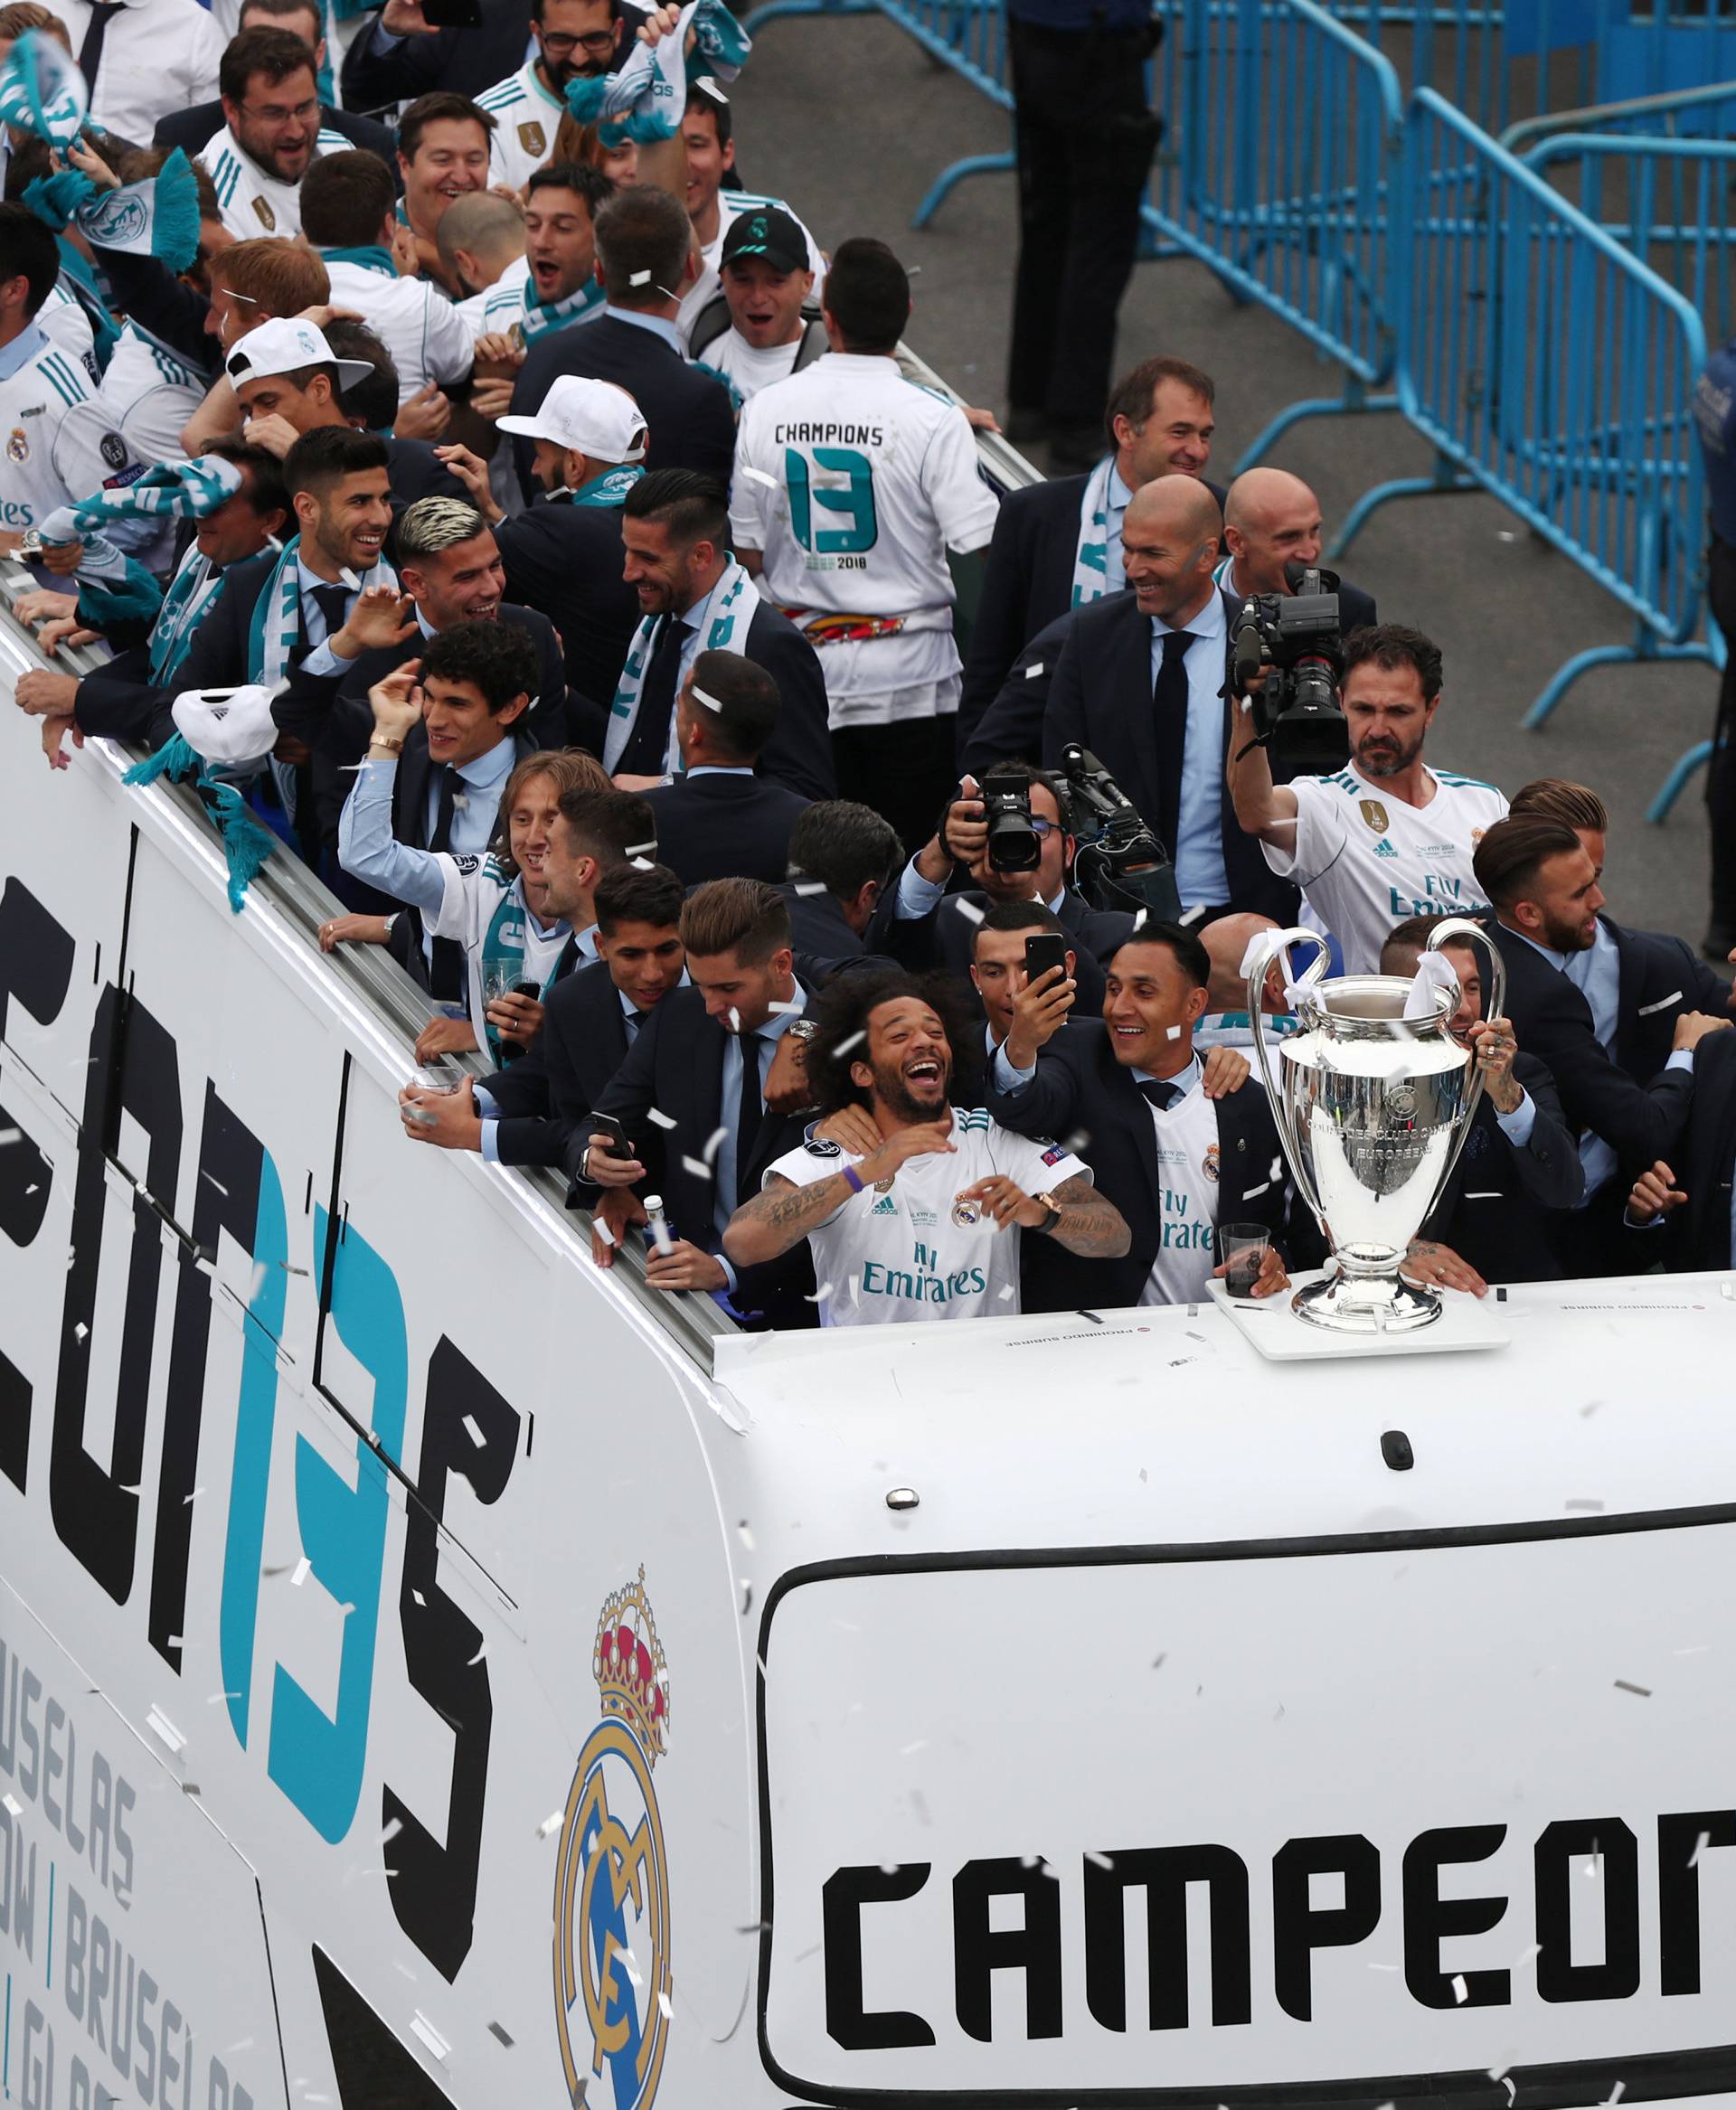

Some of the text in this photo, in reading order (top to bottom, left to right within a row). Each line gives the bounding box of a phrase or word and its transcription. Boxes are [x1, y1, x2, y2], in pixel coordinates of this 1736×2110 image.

[776, 423, 882, 446] CHAMPIONS
[0, 500, 33, 526] es
[785, 447, 879, 553] 13
[837, 556, 868, 570] 2018
[1424, 874, 1460, 900] Fly
[871, 1207, 899, 1216] adidas
[863, 1260, 986, 1304] Emirates
[1063, 1329, 1134, 1340] PROHIBIDO
[64, 1882, 254, 2110] BRUSEL
